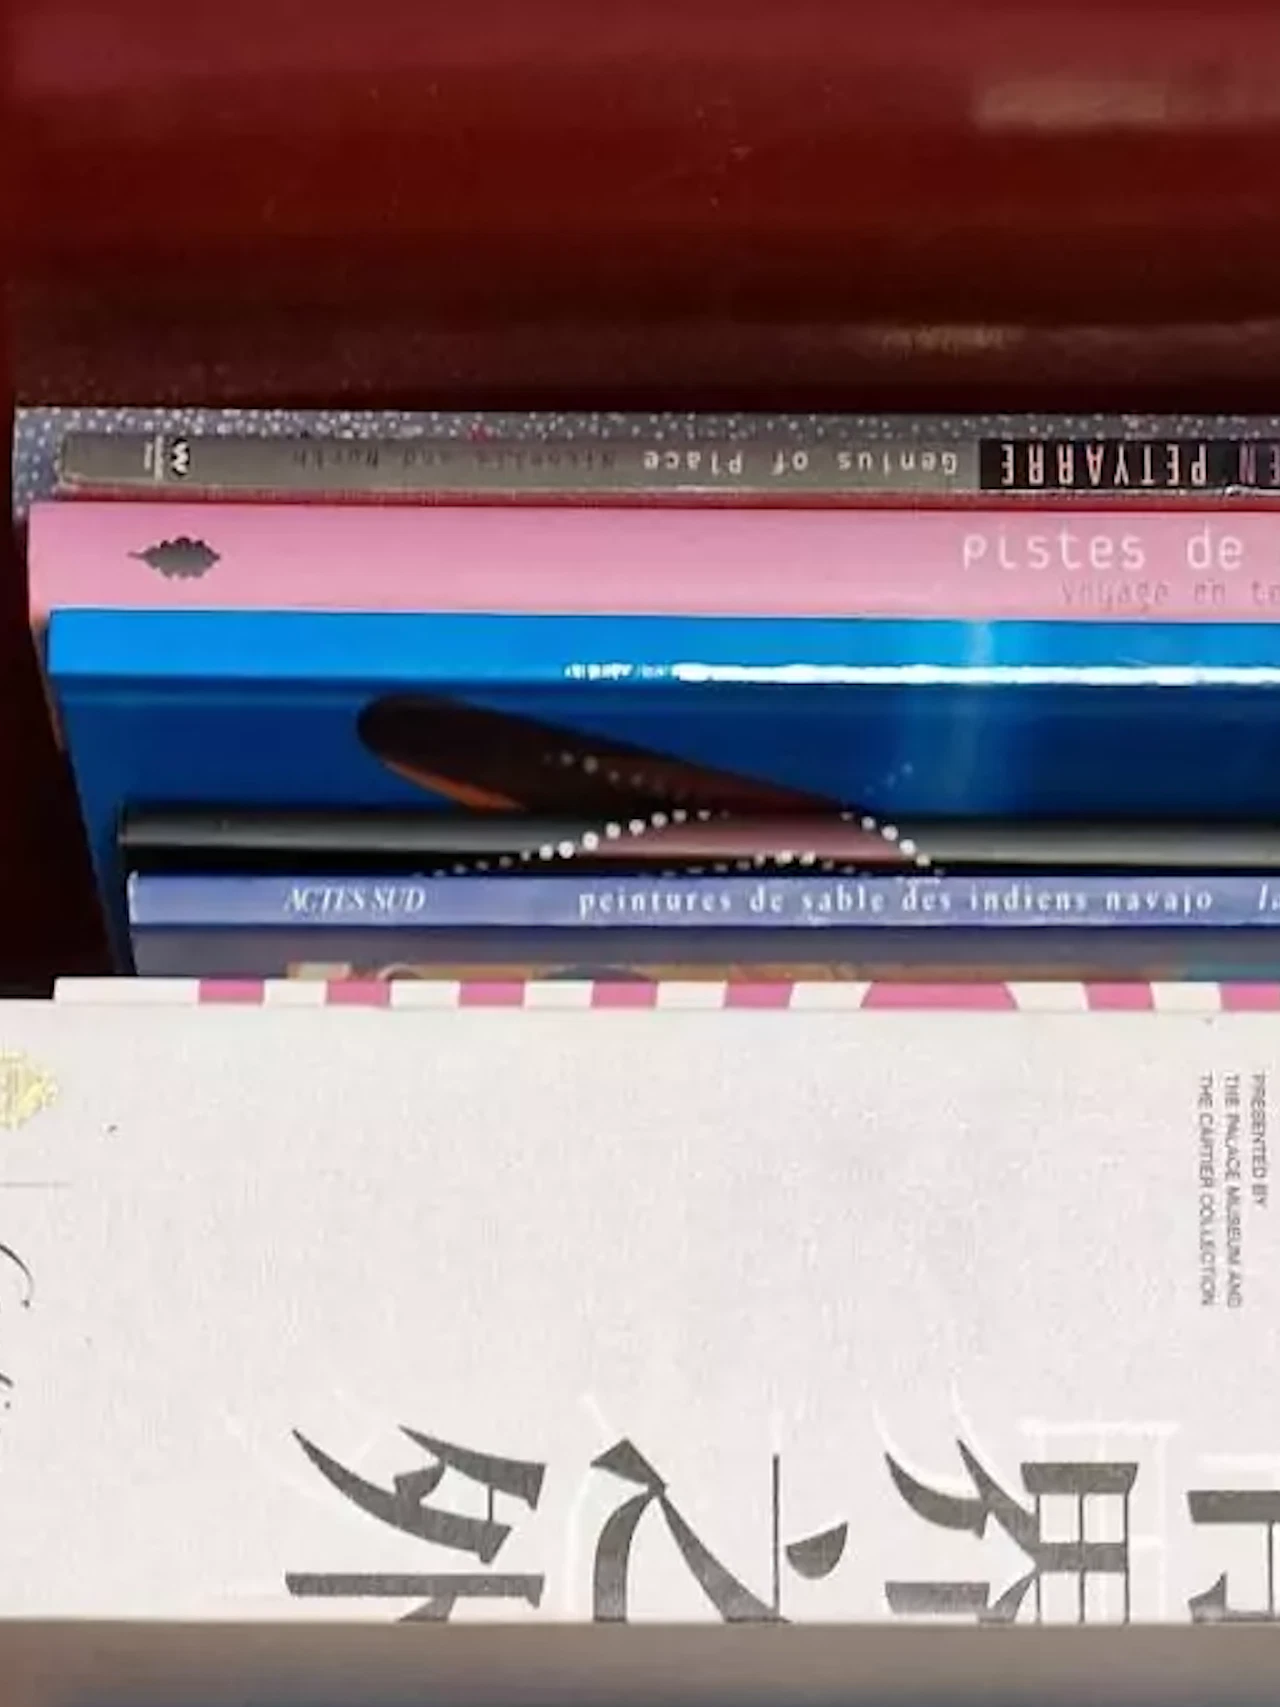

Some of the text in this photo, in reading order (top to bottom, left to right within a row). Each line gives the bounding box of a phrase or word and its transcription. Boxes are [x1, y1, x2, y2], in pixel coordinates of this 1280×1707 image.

[642, 450, 744, 476] Place
[771, 450, 810, 477] of
[837, 450, 958, 476] Genius
[999, 443, 1209, 486] PETYARRE
[1186, 526, 1243, 572] de
[283, 886, 427, 913] ACTES SUD
[578, 886, 731, 919] peintures
[748, 885, 783, 913] de
[800, 885, 884, 914] sable
[901, 885, 953, 913] des
[968, 883, 1089, 911] indiens
[1105, 884, 1213, 917] navajo
[1251, 1073, 1269, 1208] PRESENTED BY
[1198, 1073, 1216, 1307] THE CARTIER COLLECTION
[1224, 1073, 1243, 1309] THE PALACE MUSEUM AND
